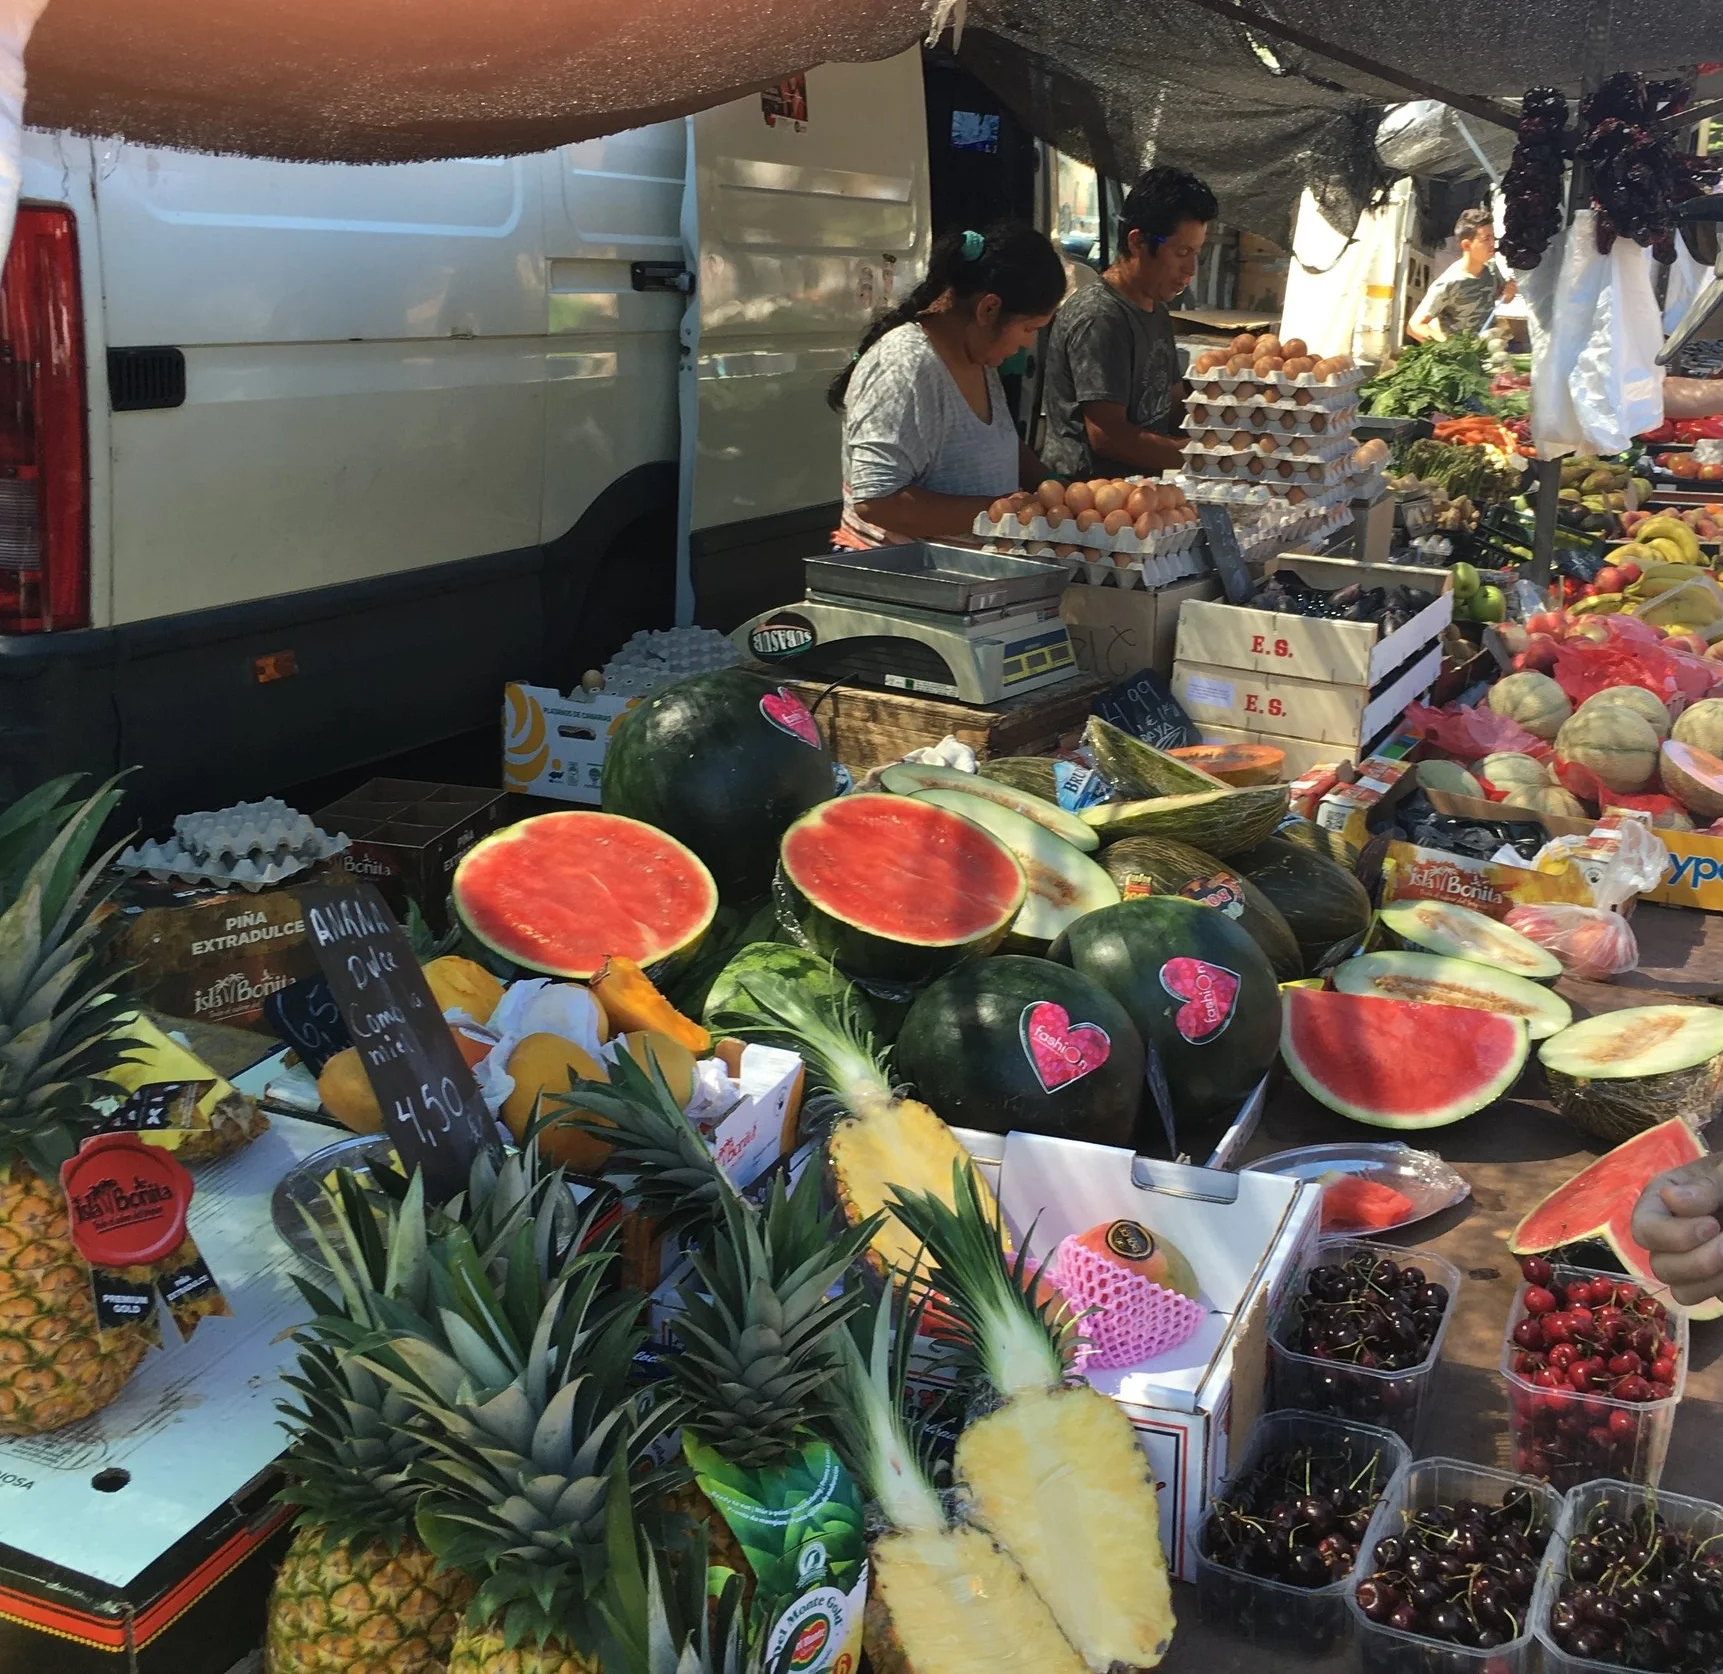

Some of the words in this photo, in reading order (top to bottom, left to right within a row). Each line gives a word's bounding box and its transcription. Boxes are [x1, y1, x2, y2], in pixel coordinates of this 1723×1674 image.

[226, 910, 268, 931] PIÑA
[191, 919, 306, 956] EXTRADULCE
[395, 1076, 464, 1148] 4,50
[102, 1294, 149, 1305] PREMIUM
[112, 1304, 141, 1314] GOLD
